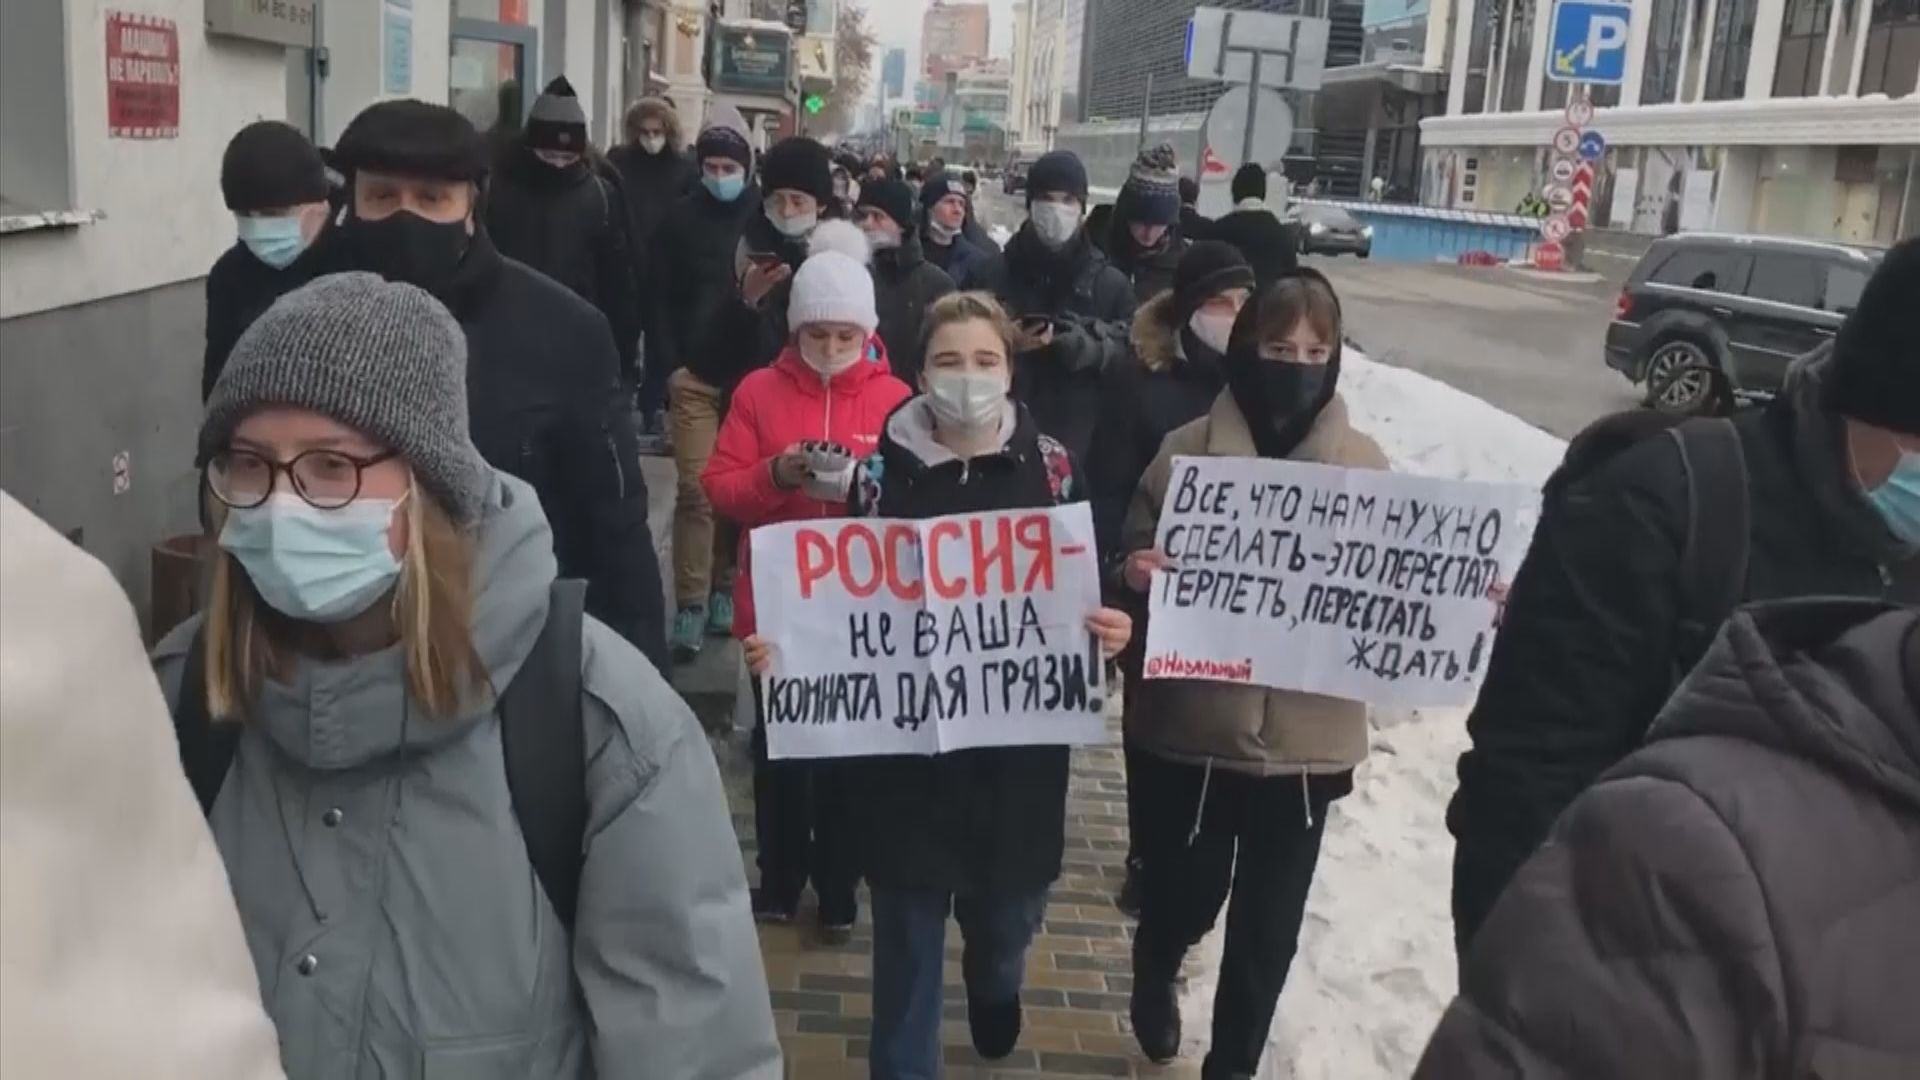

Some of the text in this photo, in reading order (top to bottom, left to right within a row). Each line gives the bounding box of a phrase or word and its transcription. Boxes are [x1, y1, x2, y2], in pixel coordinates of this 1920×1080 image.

[1584, 14, 1627, 68] P
[1250, 482, 1302, 522] ЧТО
[1307, 488, 1376, 528] НАМ
[1381, 498, 1501, 556] НУЖНО
[914, 595, 1047, 658] ВАША
[1161, 565, 1436, 641] ТЕРПЕТЬ, ПЕРЕСТАТЬ
[767, 630, 1103, 731] КОМНАТА ДЛЯ ГРЯЗИ!
[1346, 631, 1485, 682] ЖДАТЬ!
